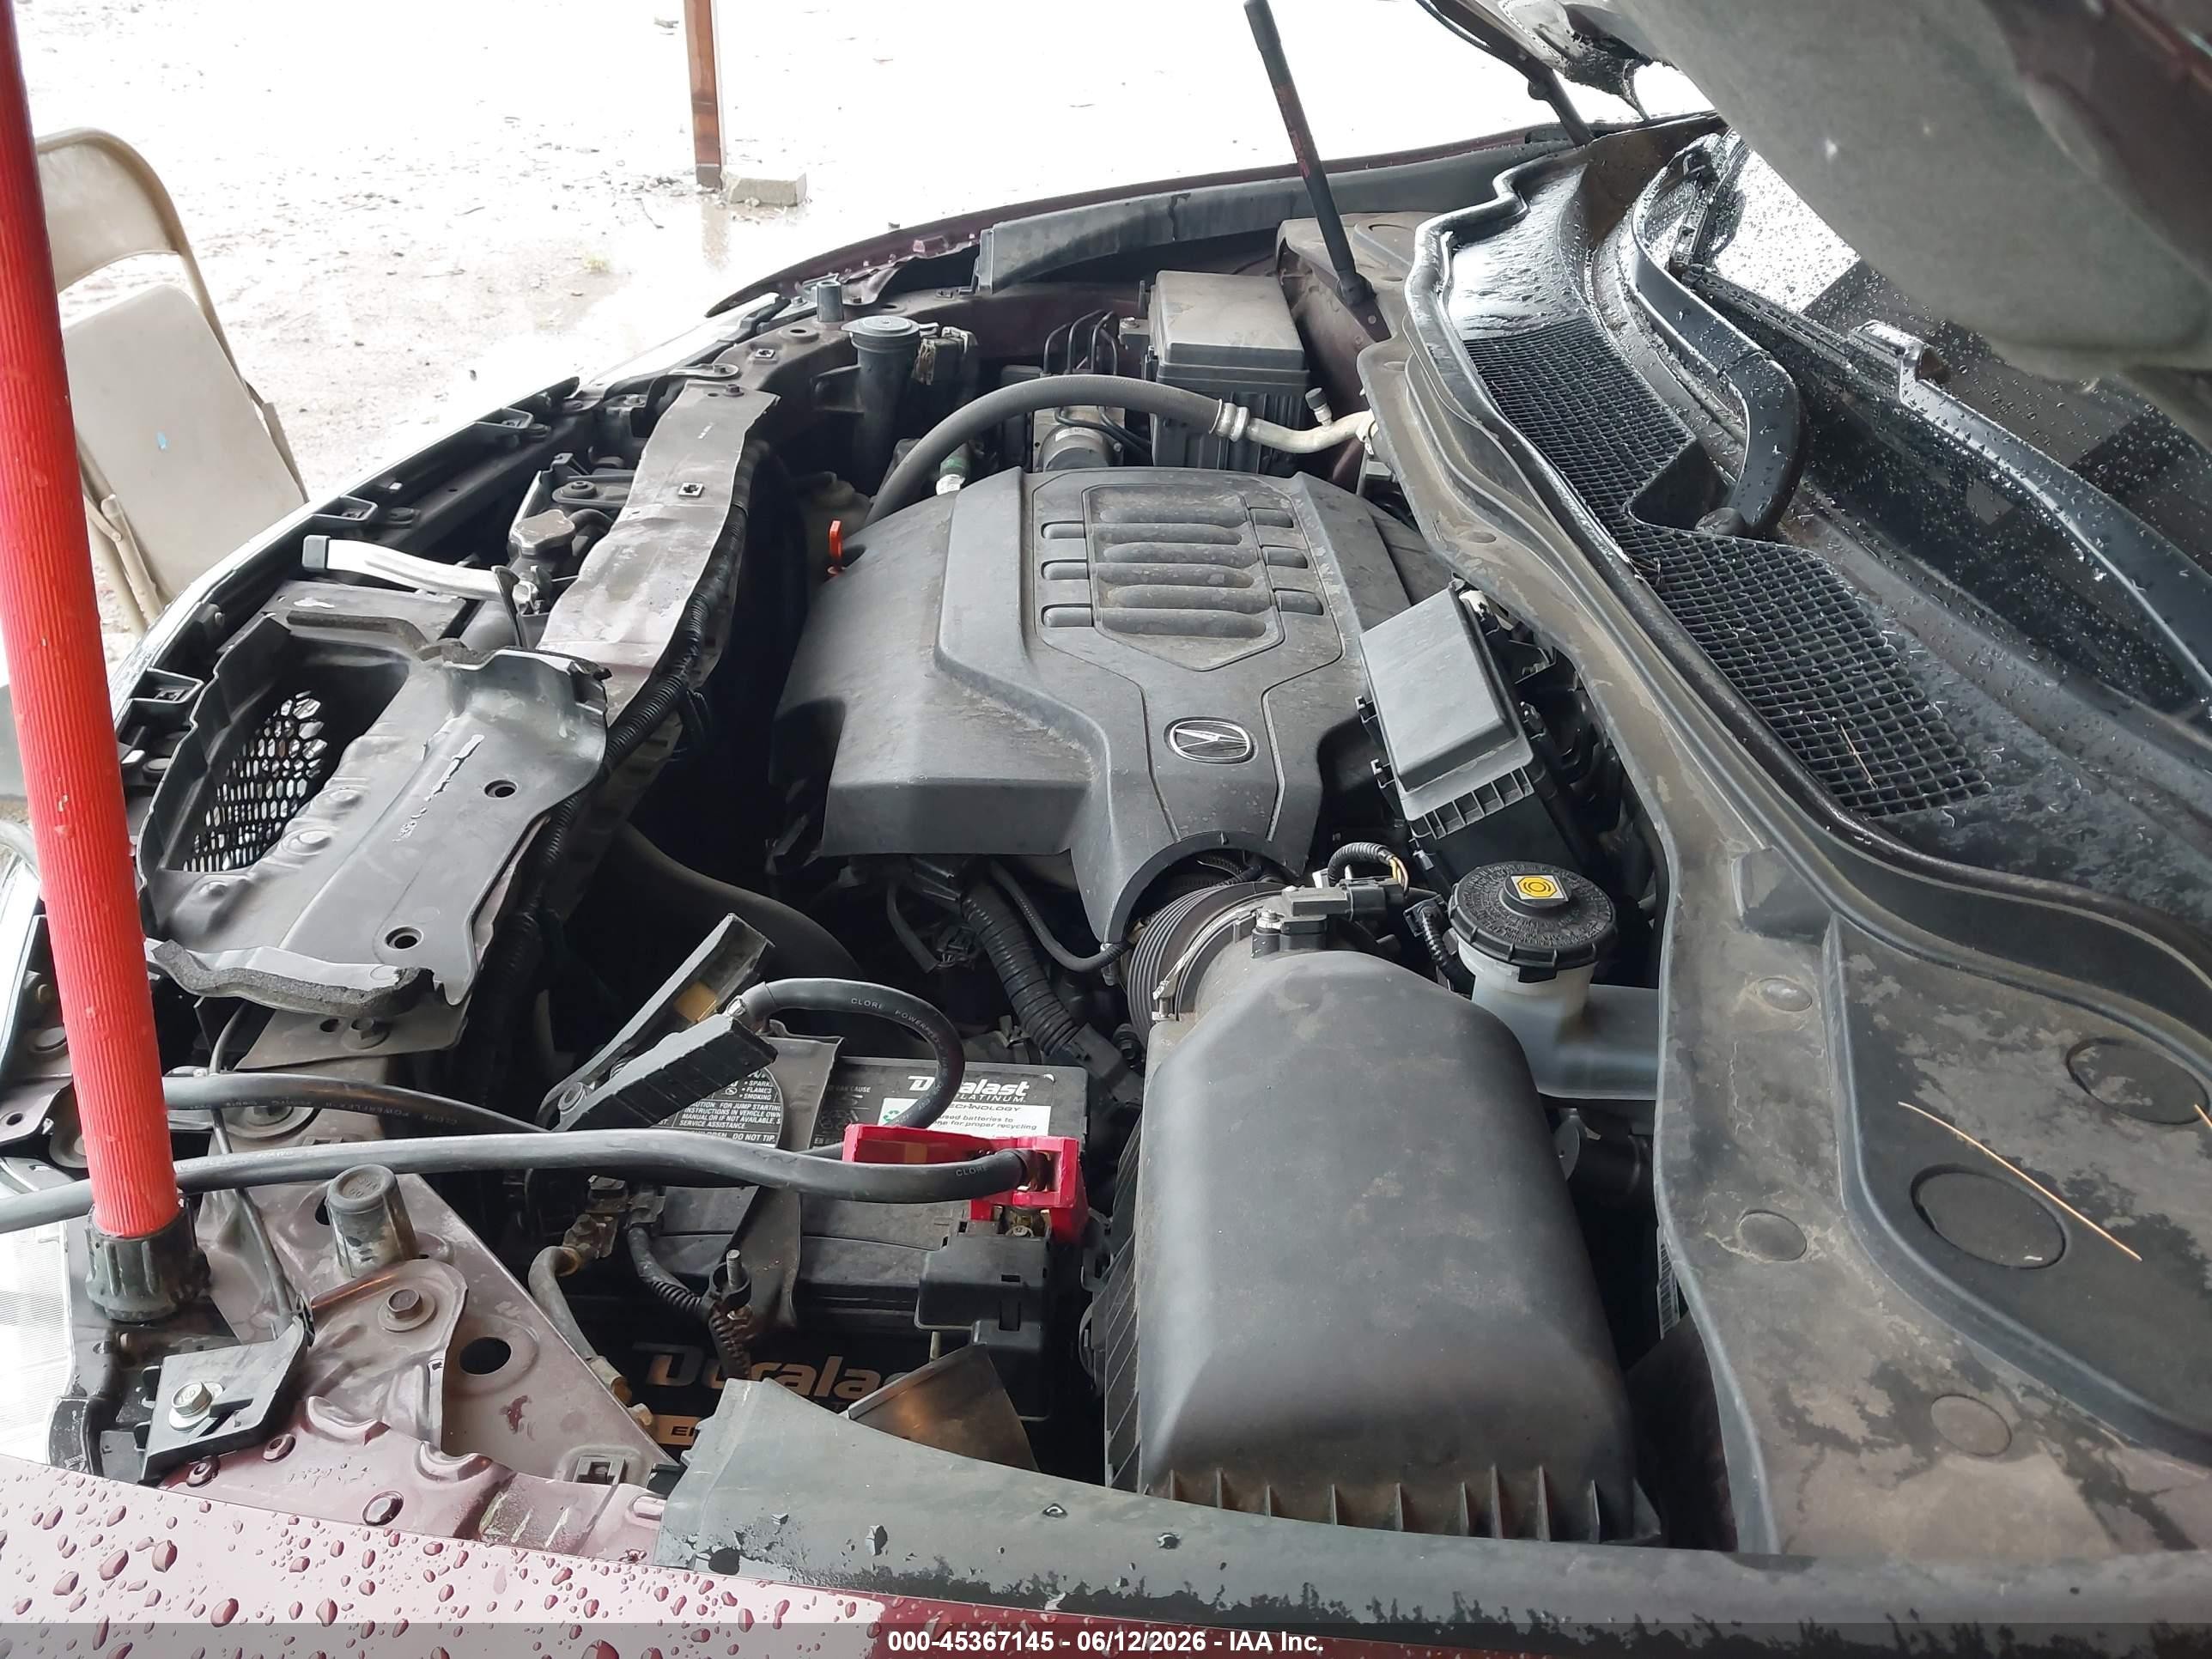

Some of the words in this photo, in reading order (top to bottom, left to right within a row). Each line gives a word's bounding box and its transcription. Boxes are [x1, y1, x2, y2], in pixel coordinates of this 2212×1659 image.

[908, 1075, 1030, 1097] Dalast
[956, 1093, 1024, 1103] LATINUM
[684, 1107, 730, 1115] INSTRUCTIONS
[948, 1103, 1022, 1112] ECHNOLOGY
[962, 1115, 1002, 1123] batteries
